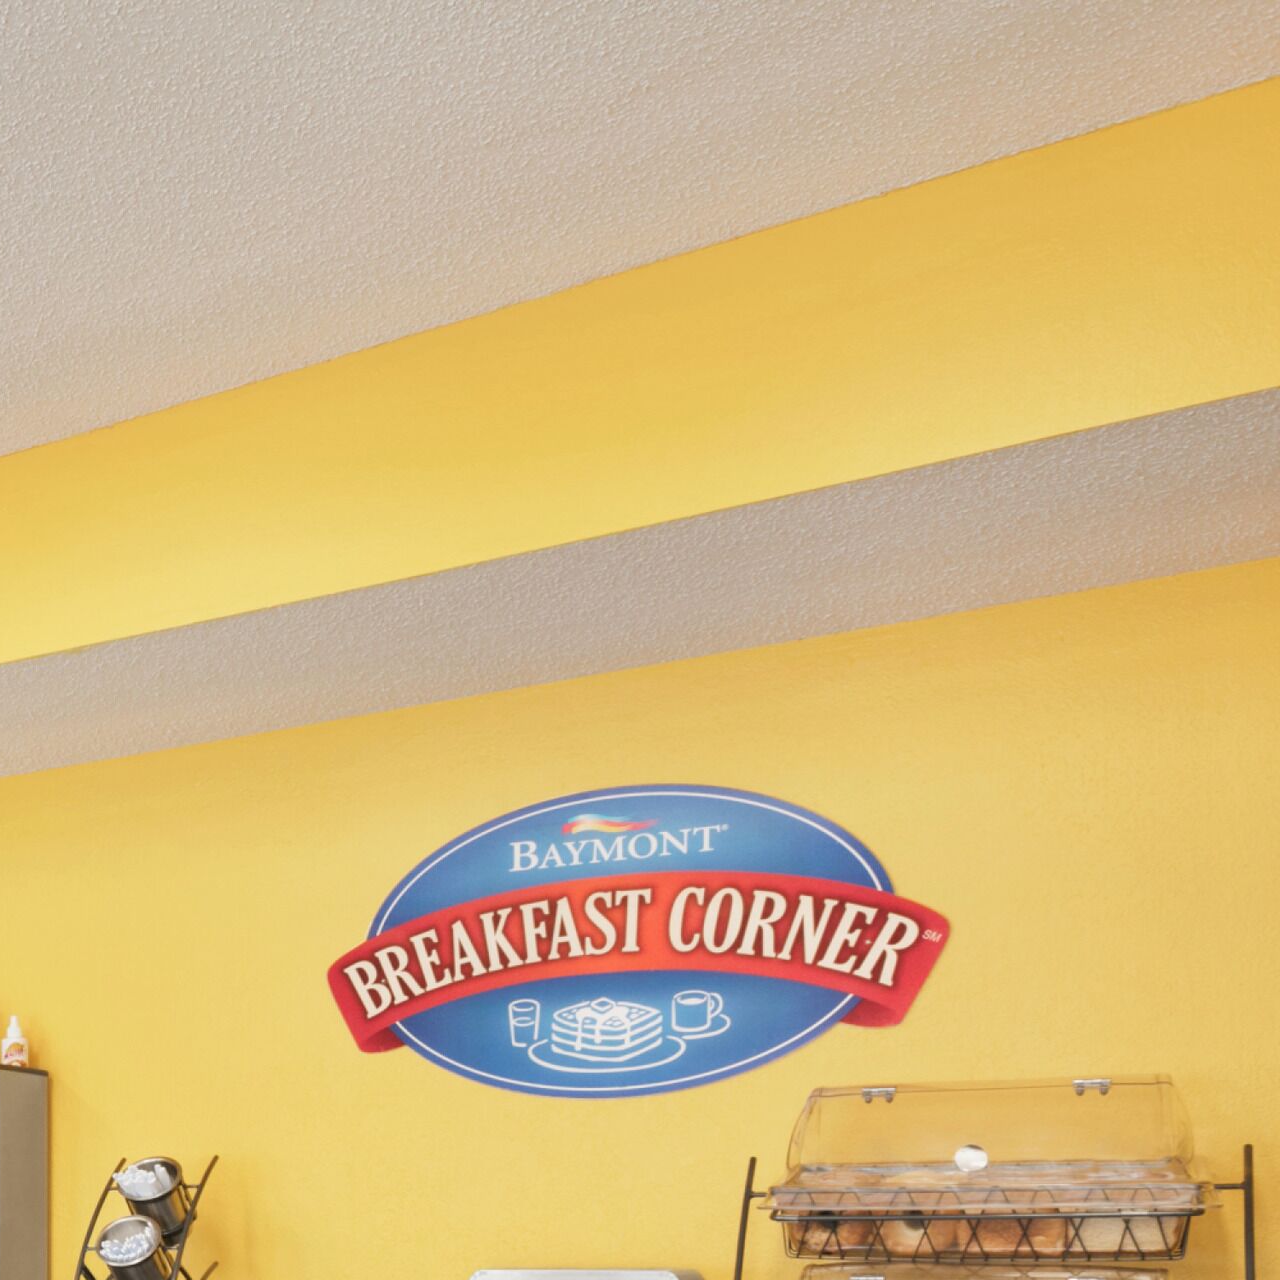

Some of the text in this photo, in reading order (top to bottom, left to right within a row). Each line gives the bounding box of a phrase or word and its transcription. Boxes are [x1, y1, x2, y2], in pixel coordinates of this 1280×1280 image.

[508, 824, 722, 873] BAYMONT
[343, 887, 653, 1021] BREAKFAST
[668, 886, 920, 988] CORNER
